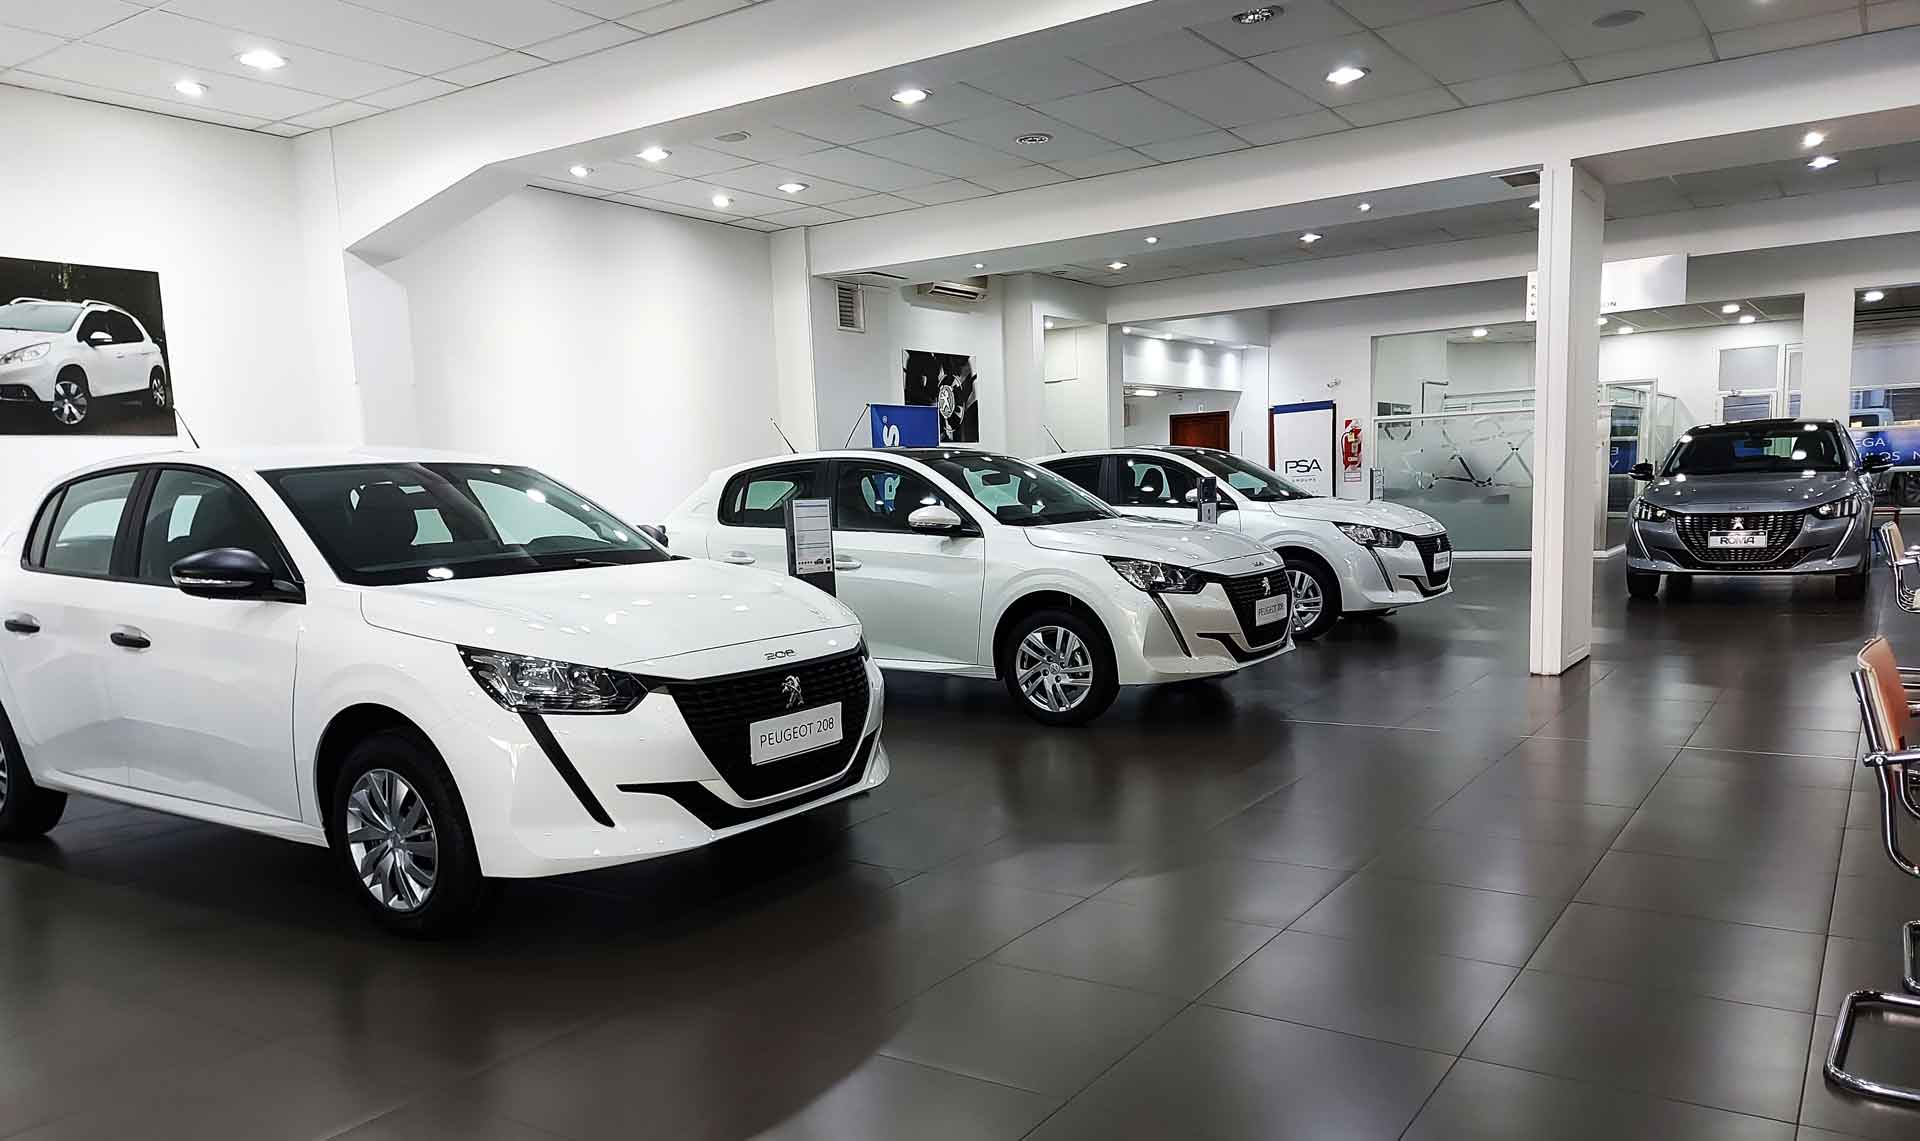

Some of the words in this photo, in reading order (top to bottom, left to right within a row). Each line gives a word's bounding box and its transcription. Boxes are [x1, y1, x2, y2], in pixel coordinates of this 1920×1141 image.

[1285, 458, 1322, 474] PSA
[1720, 536, 1755, 545] ROMA
[760, 722, 814, 750] PEUGEOT
[817, 717, 835, 734] 208
